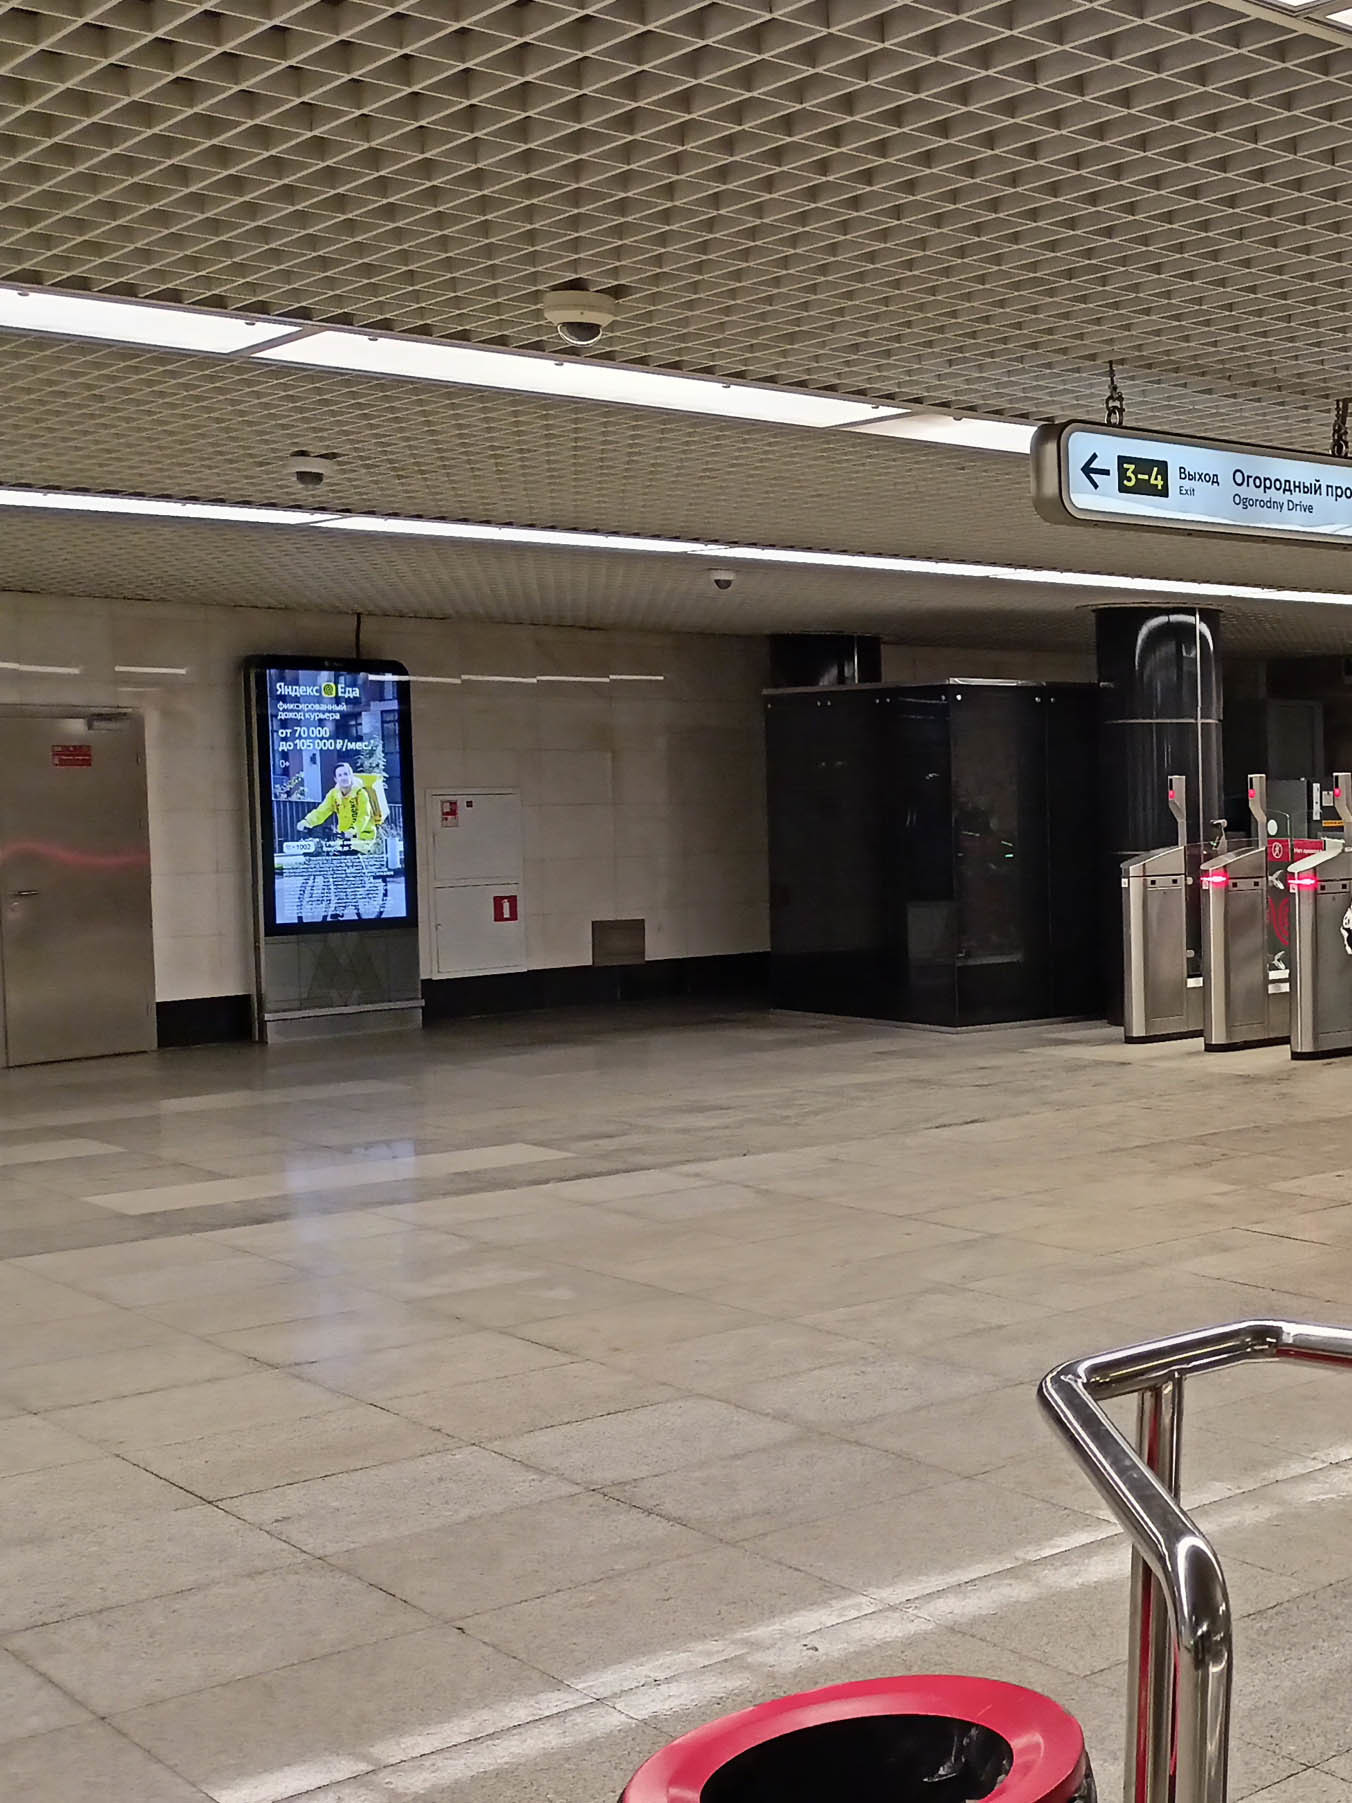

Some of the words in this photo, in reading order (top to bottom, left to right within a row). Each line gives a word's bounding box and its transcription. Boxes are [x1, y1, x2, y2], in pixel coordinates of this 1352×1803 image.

[1178, 466, 1220, 486] Выход
[1232, 468, 1322, 496] Огородный
[1179, 485, 1195, 497] Exit
[1232, 493, 1285, 513] Ogorodny
[1287, 500, 1314, 514] Drive
[276, 682, 320, 698] Яндекс
[337, 684, 360, 698] Еда
[277, 701, 347, 712] фиксированный
[277, 712, 304, 720] доход
[305, 711, 341, 721] курьера
[278, 729, 292, 738] от
[293, 726, 307, 738] 70
[309, 727, 330, 738] 000
[278, 741, 294, 752] до
[295, 739, 313, 750] 105
[315, 739, 335, 750] 000
